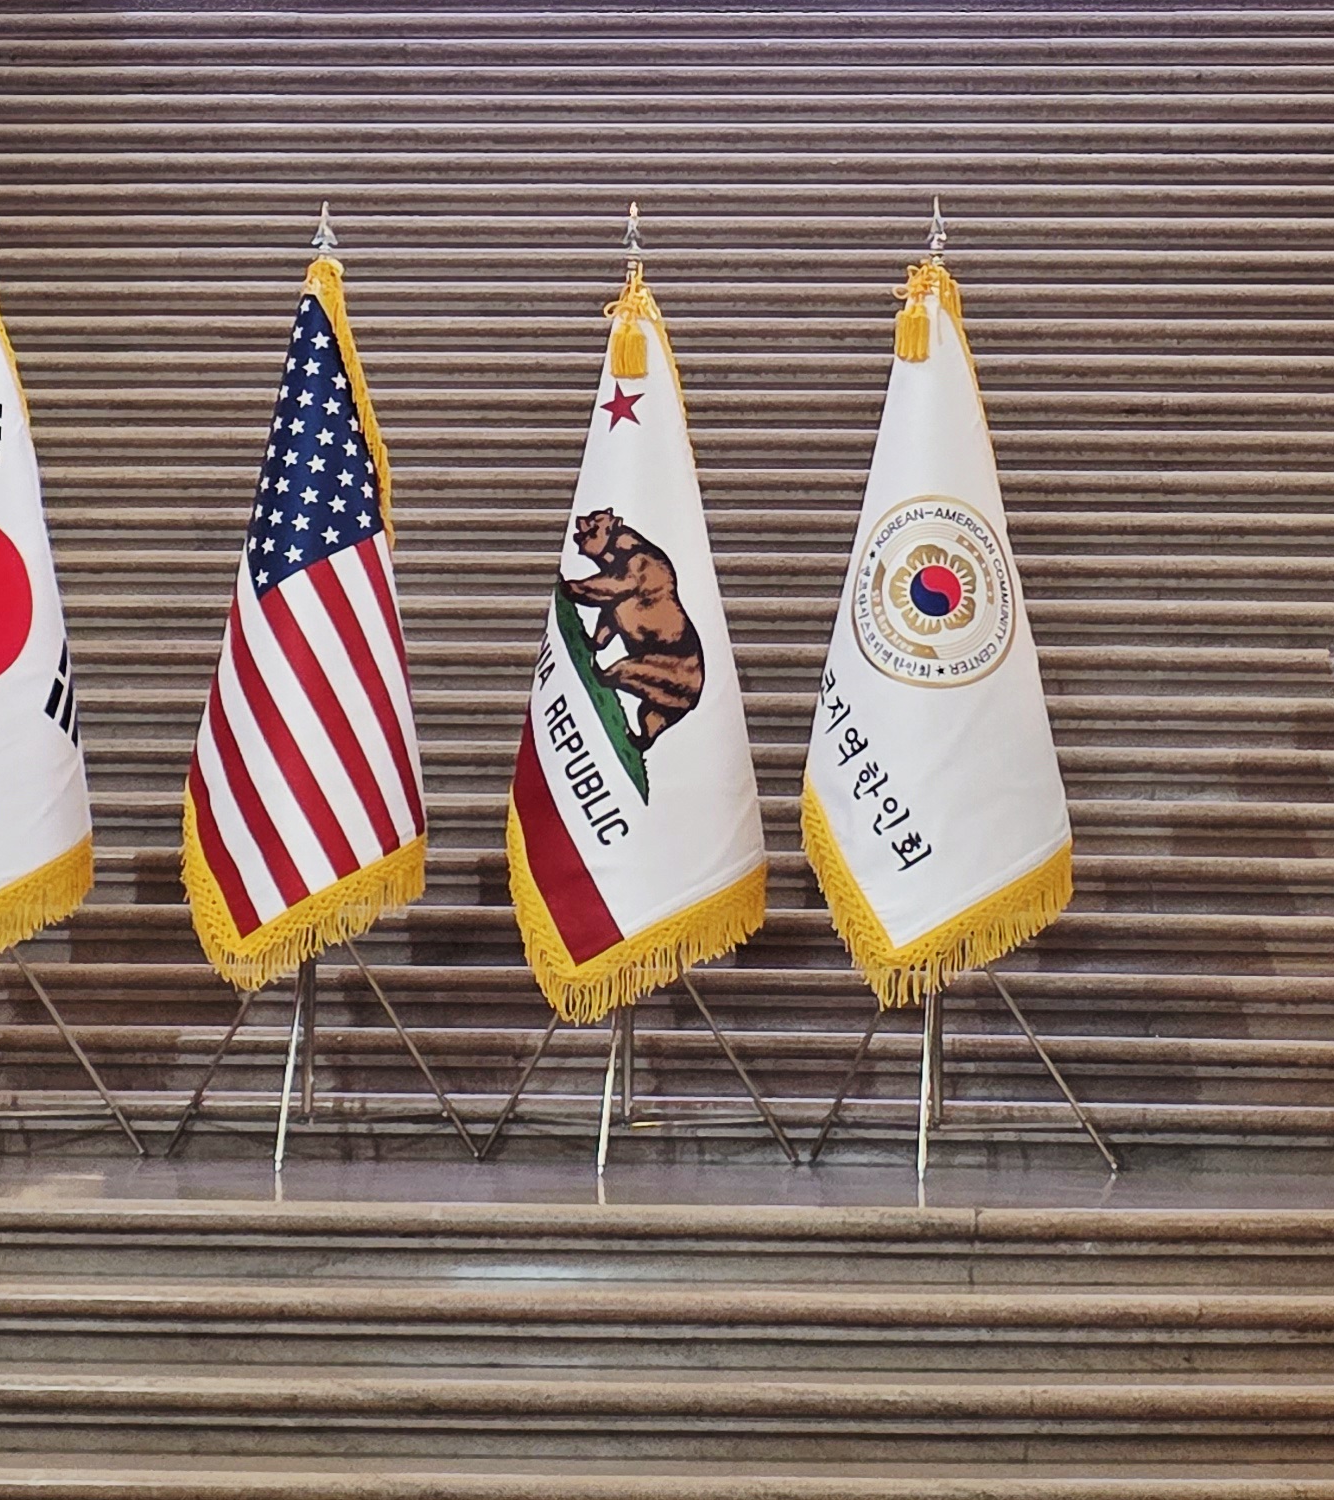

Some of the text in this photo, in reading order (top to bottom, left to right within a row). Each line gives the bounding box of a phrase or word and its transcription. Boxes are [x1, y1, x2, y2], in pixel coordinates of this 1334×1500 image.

[875, 508, 1010, 675] KOREAN-AMERICAN COMMUNITY CENTER
[544, 694, 629, 845] REPUBLIC
